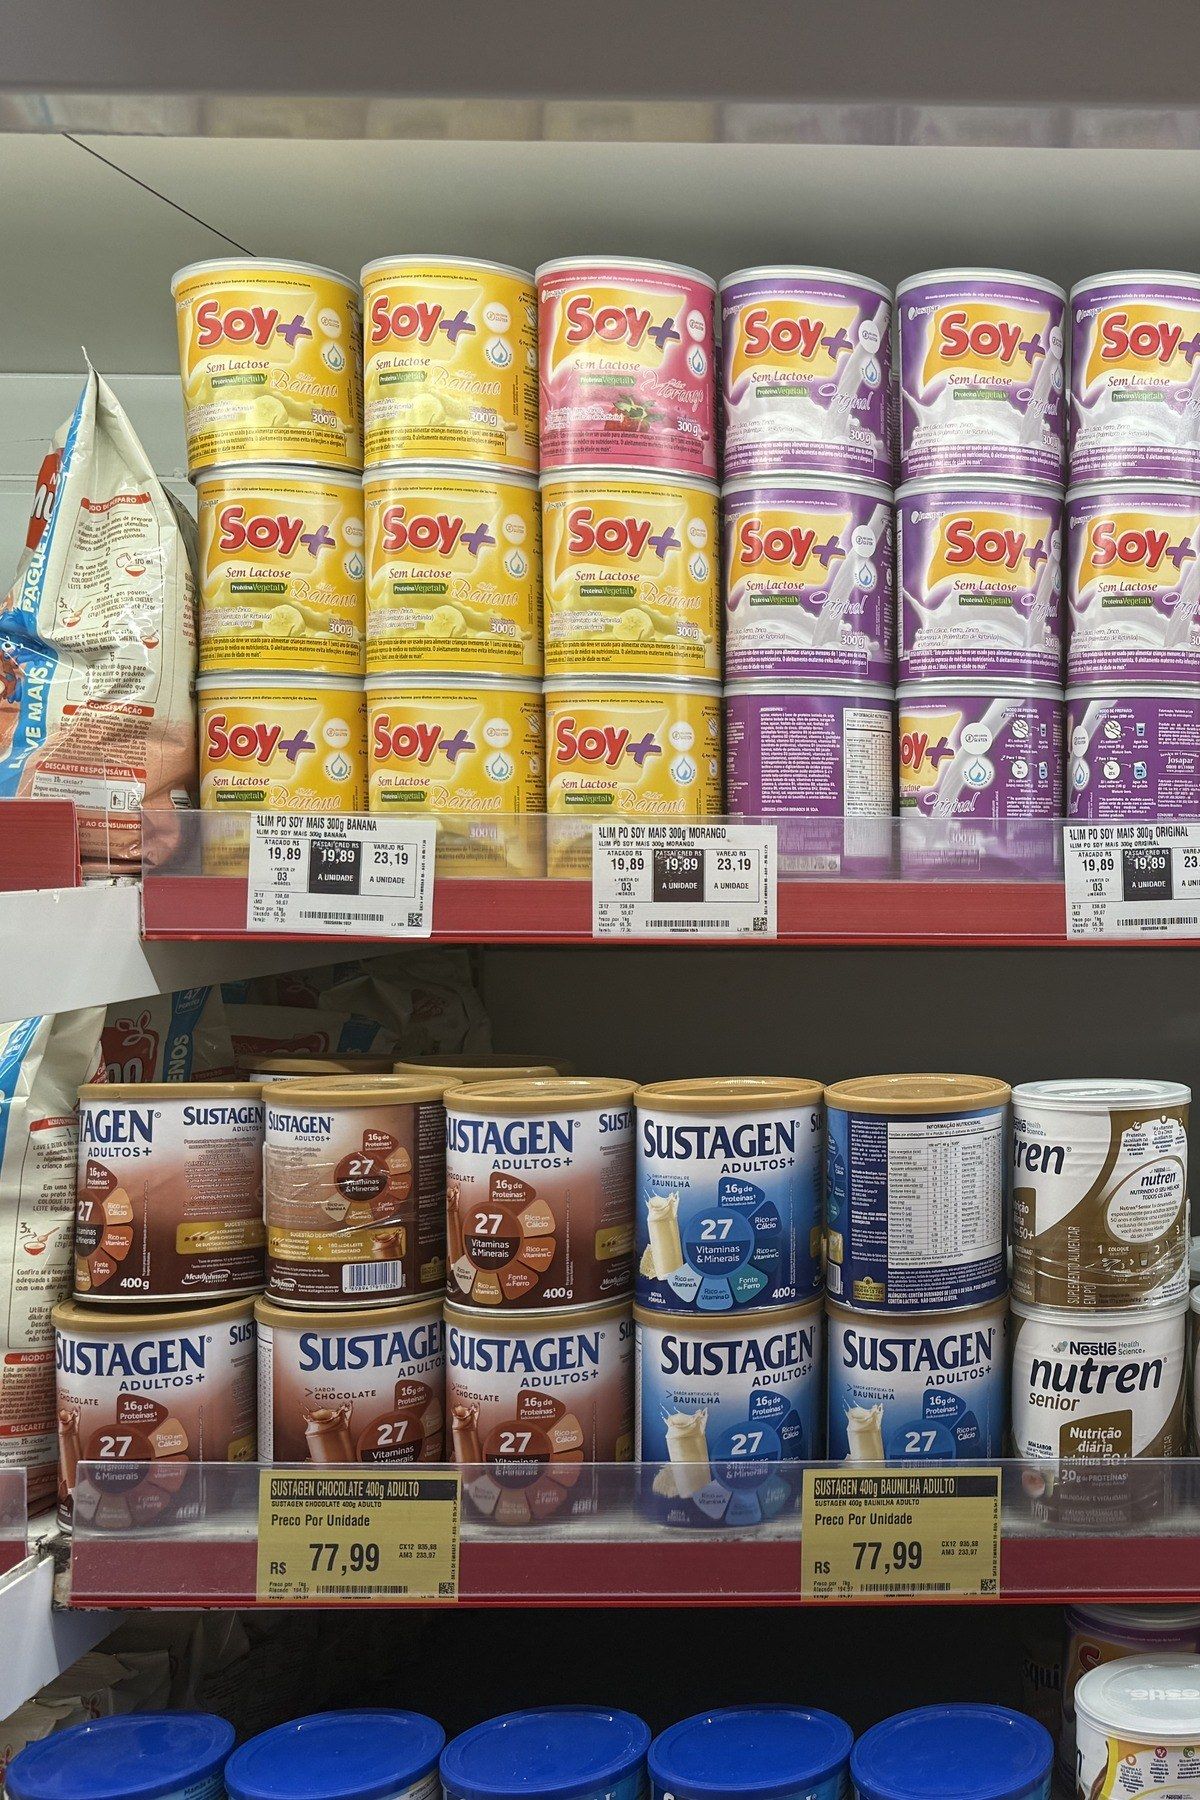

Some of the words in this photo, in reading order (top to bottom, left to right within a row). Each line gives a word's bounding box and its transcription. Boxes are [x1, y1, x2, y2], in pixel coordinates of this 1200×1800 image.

[206, 361, 226, 374] Sem
[228, 359, 270, 371] Lactose
[751, 371, 772, 382] Sem
[774, 371, 814, 382] Lactose
[388, 568, 412, 579] Sem
[414, 568, 452, 579] Lactose
[44, 762, 78, 772] DESCARTE
[276, 817, 287, 827] PO
[289, 817, 303, 828] SOY
[306, 817, 325, 829] MAIS
[327, 818, 344, 832] 300g
[347, 818, 377, 831] BANANA
[618, 827, 628, 839] PO
[631, 827, 645, 839] SOY
[649, 827, 666, 839] MAIS
[669, 827, 686, 841] 300g
[689, 827, 726, 839] MORANGO
[1088, 828, 1098, 840] PO
[1100, 828, 1113, 839] SOY
[1117, 827, 1135, 839] MAIS
[1137, 827, 1153, 840] 300g
[1156, 826, 1189, 838] ORIGINAL
[268, 847, 301, 862] 19,89
[321, 849, 355, 863] 19,89
[374, 852, 408, 866] 23,19
[611, 858, 644, 872] 19,89
[717, 858, 751, 871] 23,19
[1082, 859, 1114, 872] 19,89
[349, 1159, 374, 1176] 27
[651, 1179, 691, 1188] BAUNILHA
[1141, 1172, 1176, 1187] nutren
[474, 1212, 503, 1234] 27
[700, 1218, 734, 1241] 27
[696, 1246, 741, 1255] Vitaminas
[120, 1277, 150, 1291] 400g
[542, 1288, 573, 1300] 400g
[1069, 1341, 1117, 1356] Nestlé
[1029, 1358, 1164, 1395] nutren
[314, 1389, 377, 1401] CHOCOLATE
[1028, 1391, 1080, 1412] senior
[272, 1480, 314, 1497] SUSTAGEN
[317, 1480, 363, 1497] CHOCOLATE
[366, 1480, 384, 1500] 400g
[387, 1481, 419, 1497] ADULTO
[815, 1478, 858, 1496] SUSTAGEN
[859, 1478, 878, 1498] 400g
[880, 1478, 920, 1495] BAUNILHA
[923, 1478, 955, 1494] ADULTO
[271, 1514, 300, 1526] Preco
[305, 1514, 323, 1526] Por
[327, 1514, 370, 1527] Unidade
[815, 1514, 844, 1525] Preco
[849, 1514, 866, 1525] Por
[870, 1513, 912, 1525] Unidade
[270, 1562, 287, 1575] R$
[309, 1543, 380, 1576] 77,99
[814, 1561, 830, 1574] R$
[853, 1541, 922, 1575] 77,99
